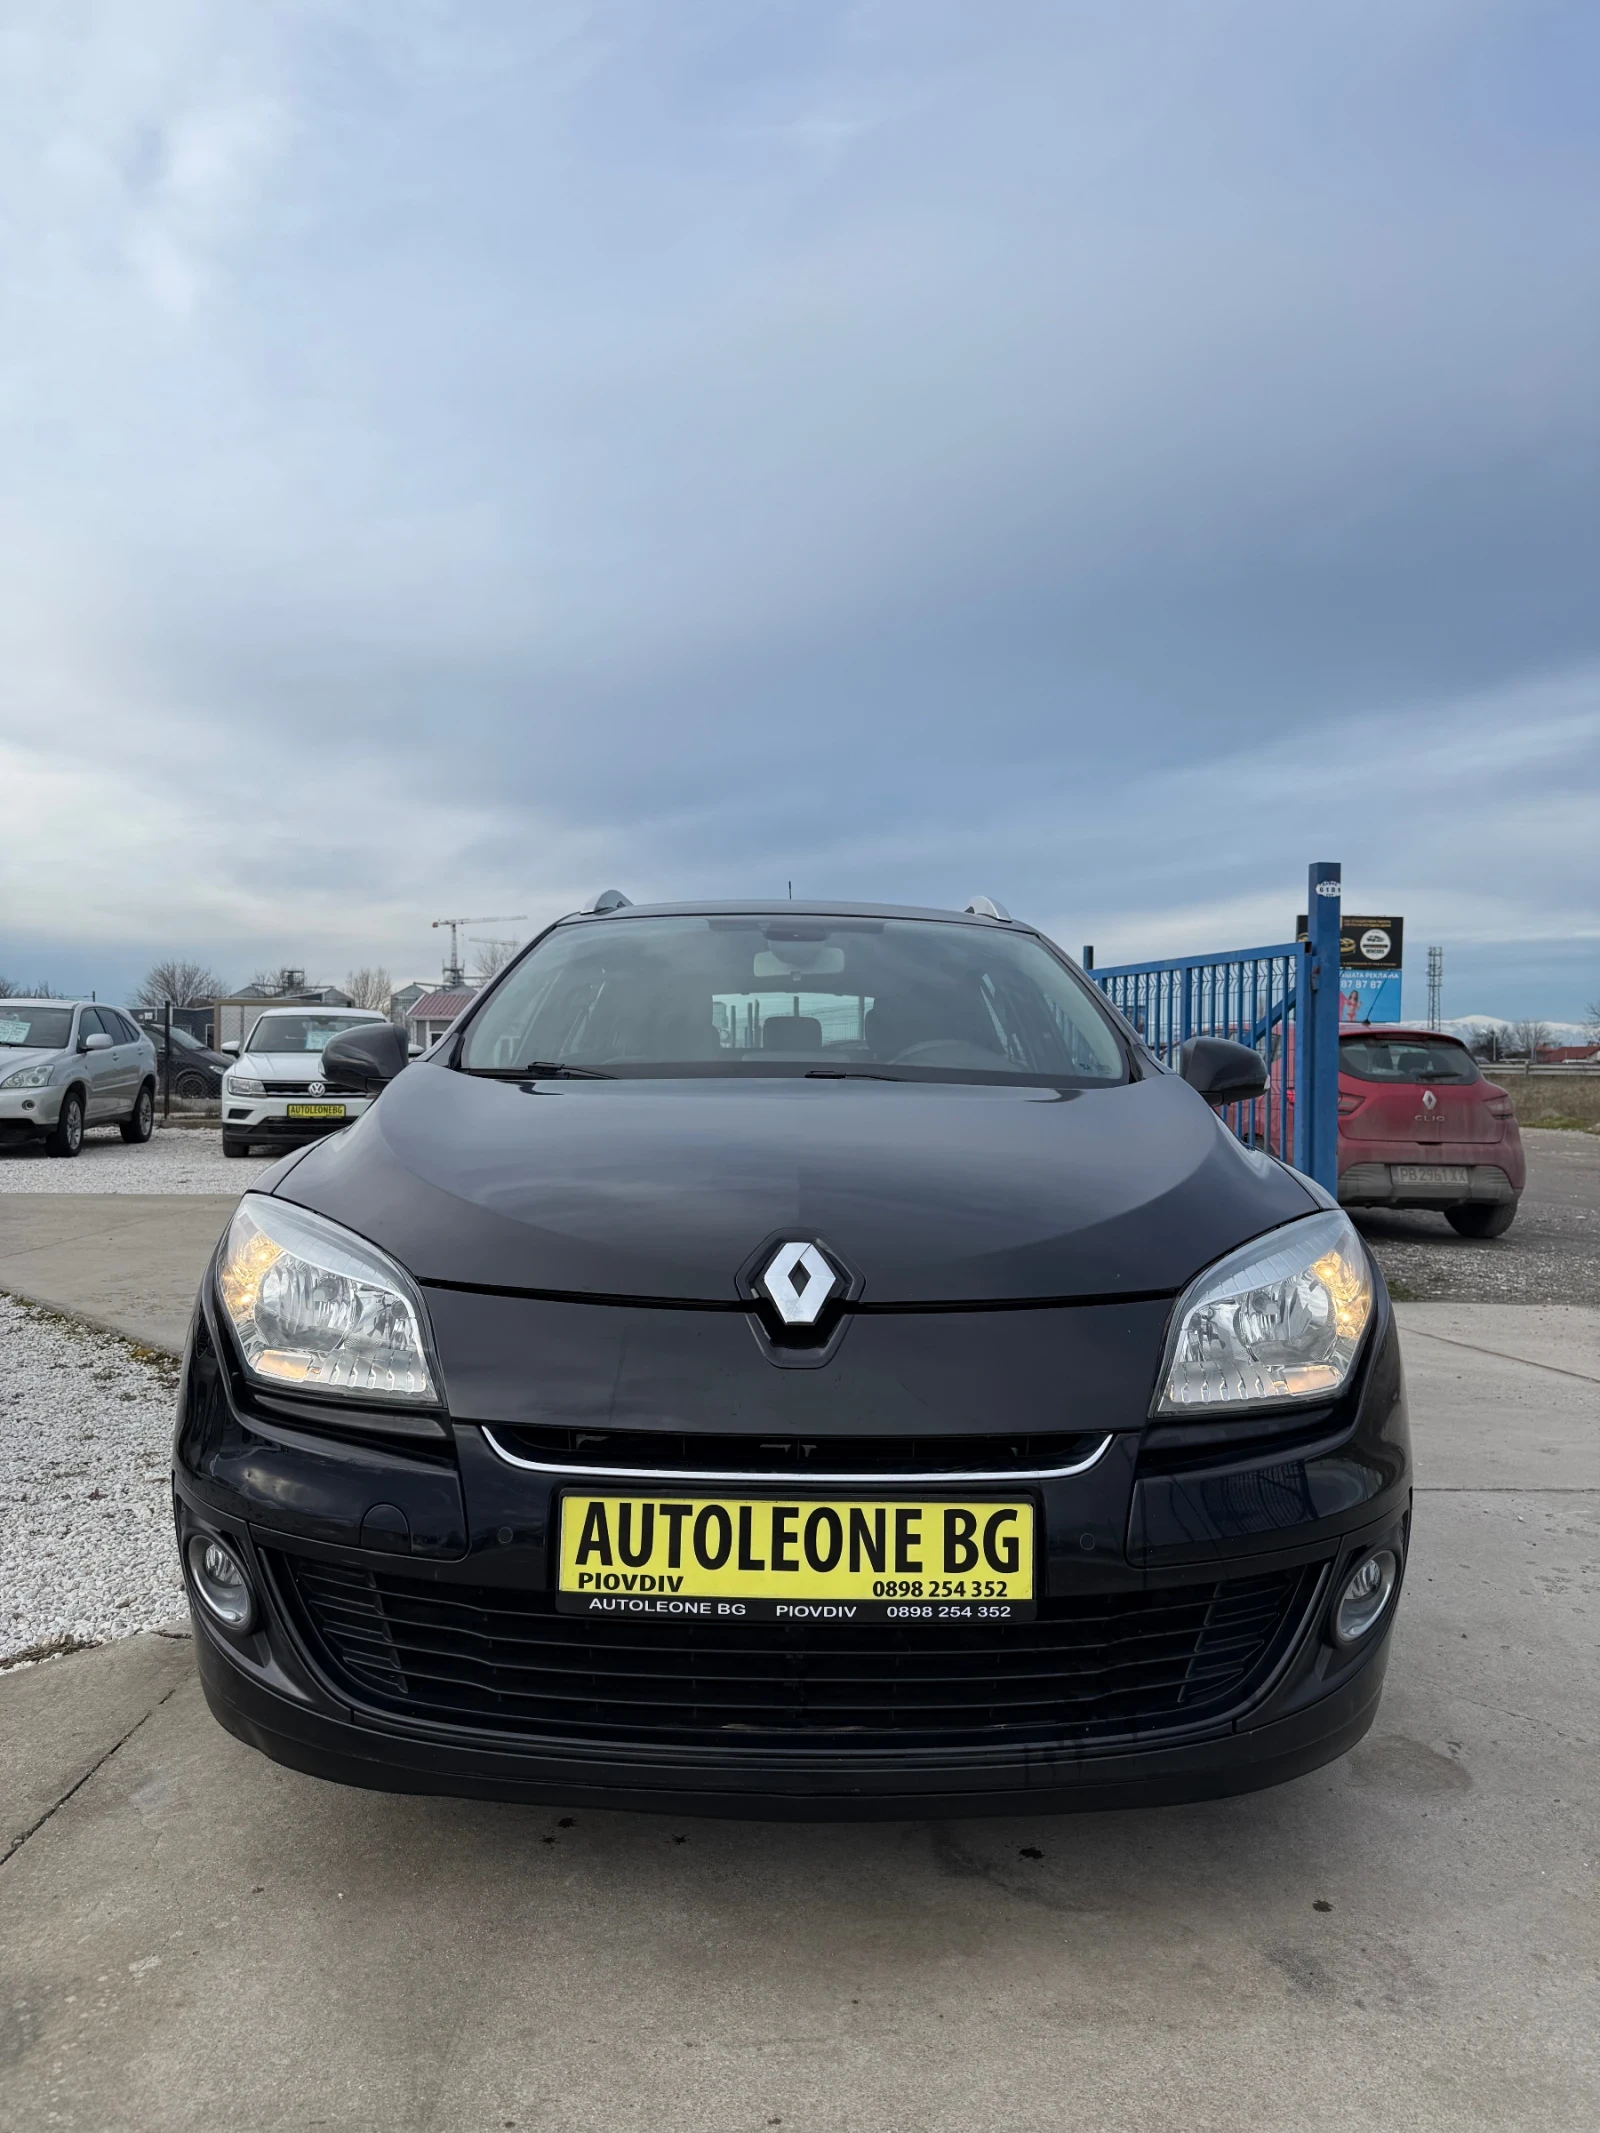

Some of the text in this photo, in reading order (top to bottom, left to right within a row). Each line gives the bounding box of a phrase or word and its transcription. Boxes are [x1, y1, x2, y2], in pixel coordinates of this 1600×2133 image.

[1340, 971, 1365, 979] АШАТА
[1341, 980, 1383, 989] 87 87 87
[575, 1501, 1020, 1574] AUTOLEONE BG
[578, 1572, 684, 1593] PIOVDIV
[872, 1580, 1008, 1598] 0898 254 352
[589, 1598, 1012, 1618] AUTOLEONE BG PIOVDIV 0898 254 352
